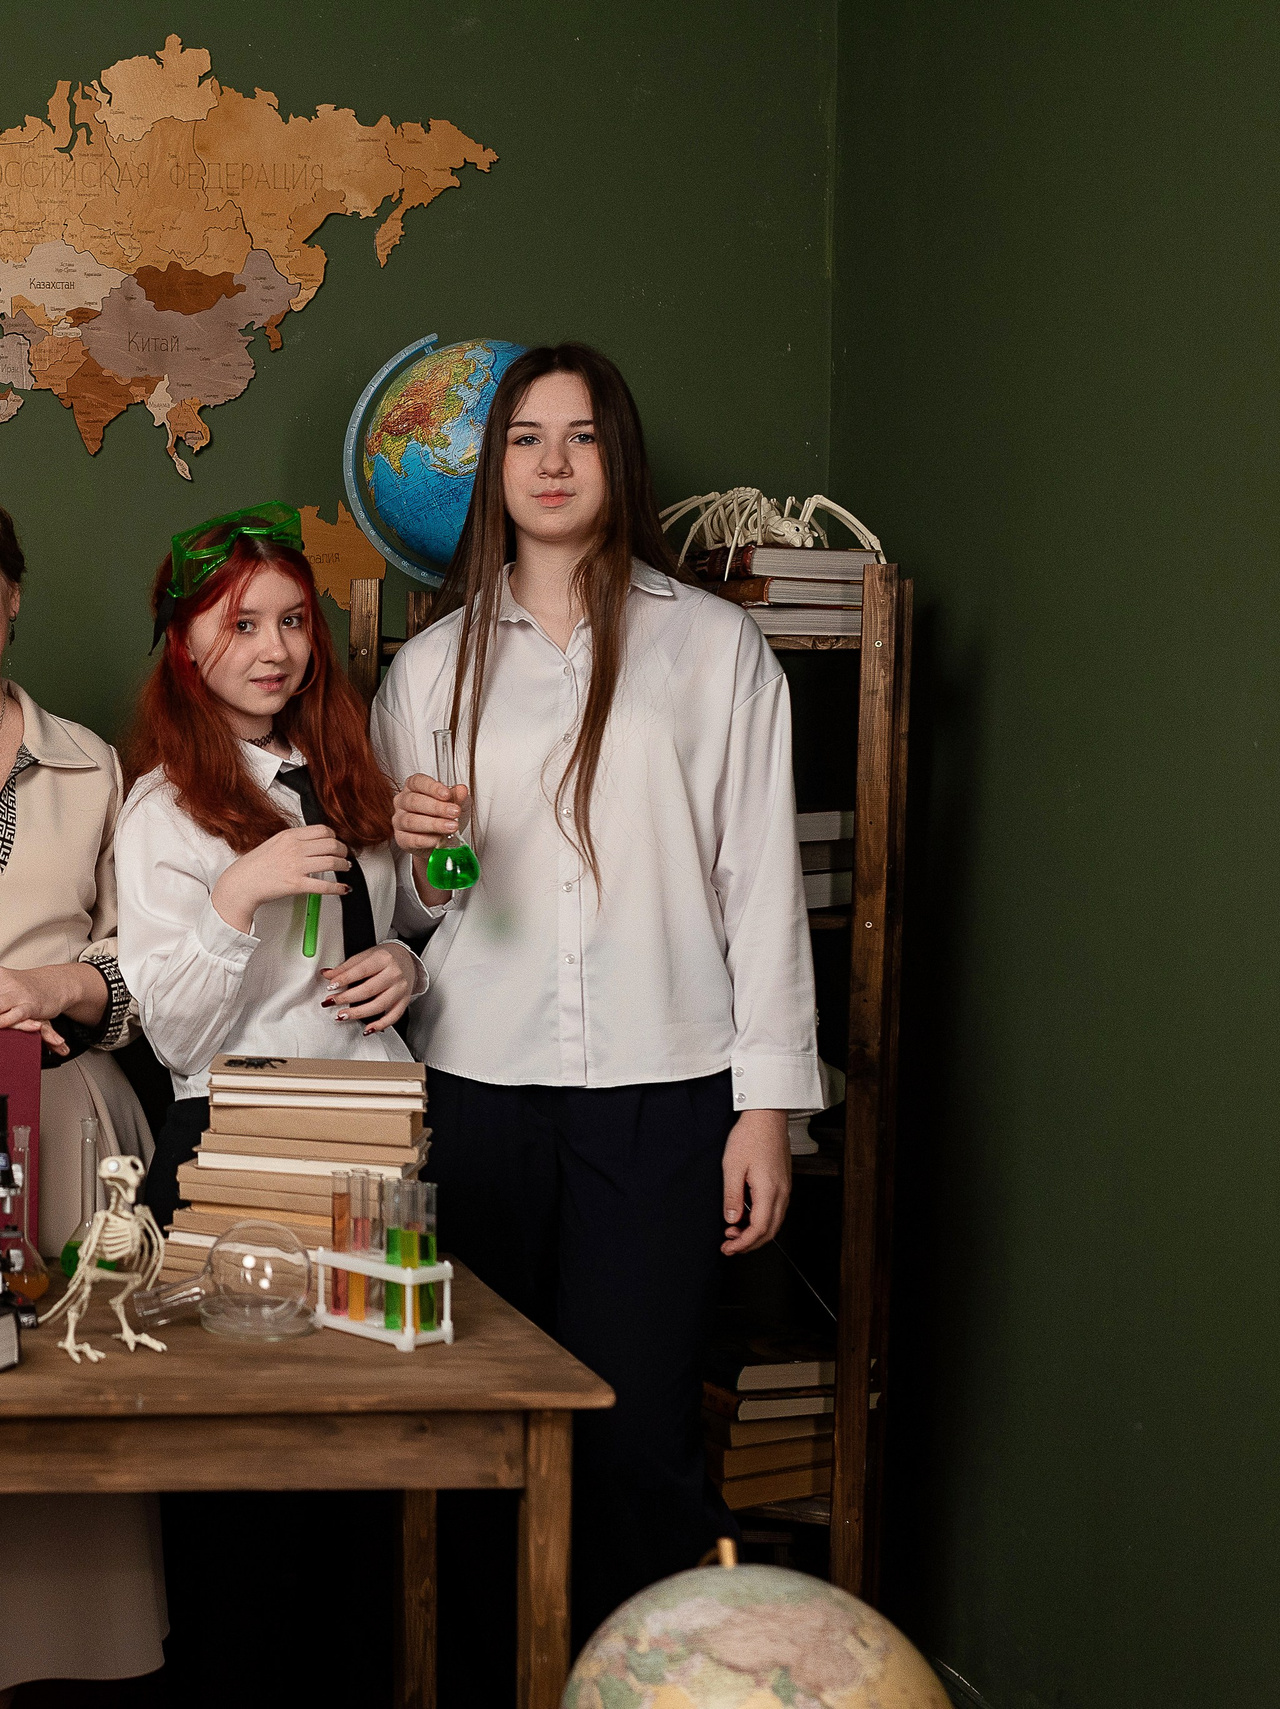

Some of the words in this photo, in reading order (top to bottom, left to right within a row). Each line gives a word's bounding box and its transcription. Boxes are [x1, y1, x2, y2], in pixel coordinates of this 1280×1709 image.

[169, 162, 324, 192] ФЕДЕРАЦИЯ
[29, 278, 75, 290] Казахстан
[128, 331, 180, 352] Китай
